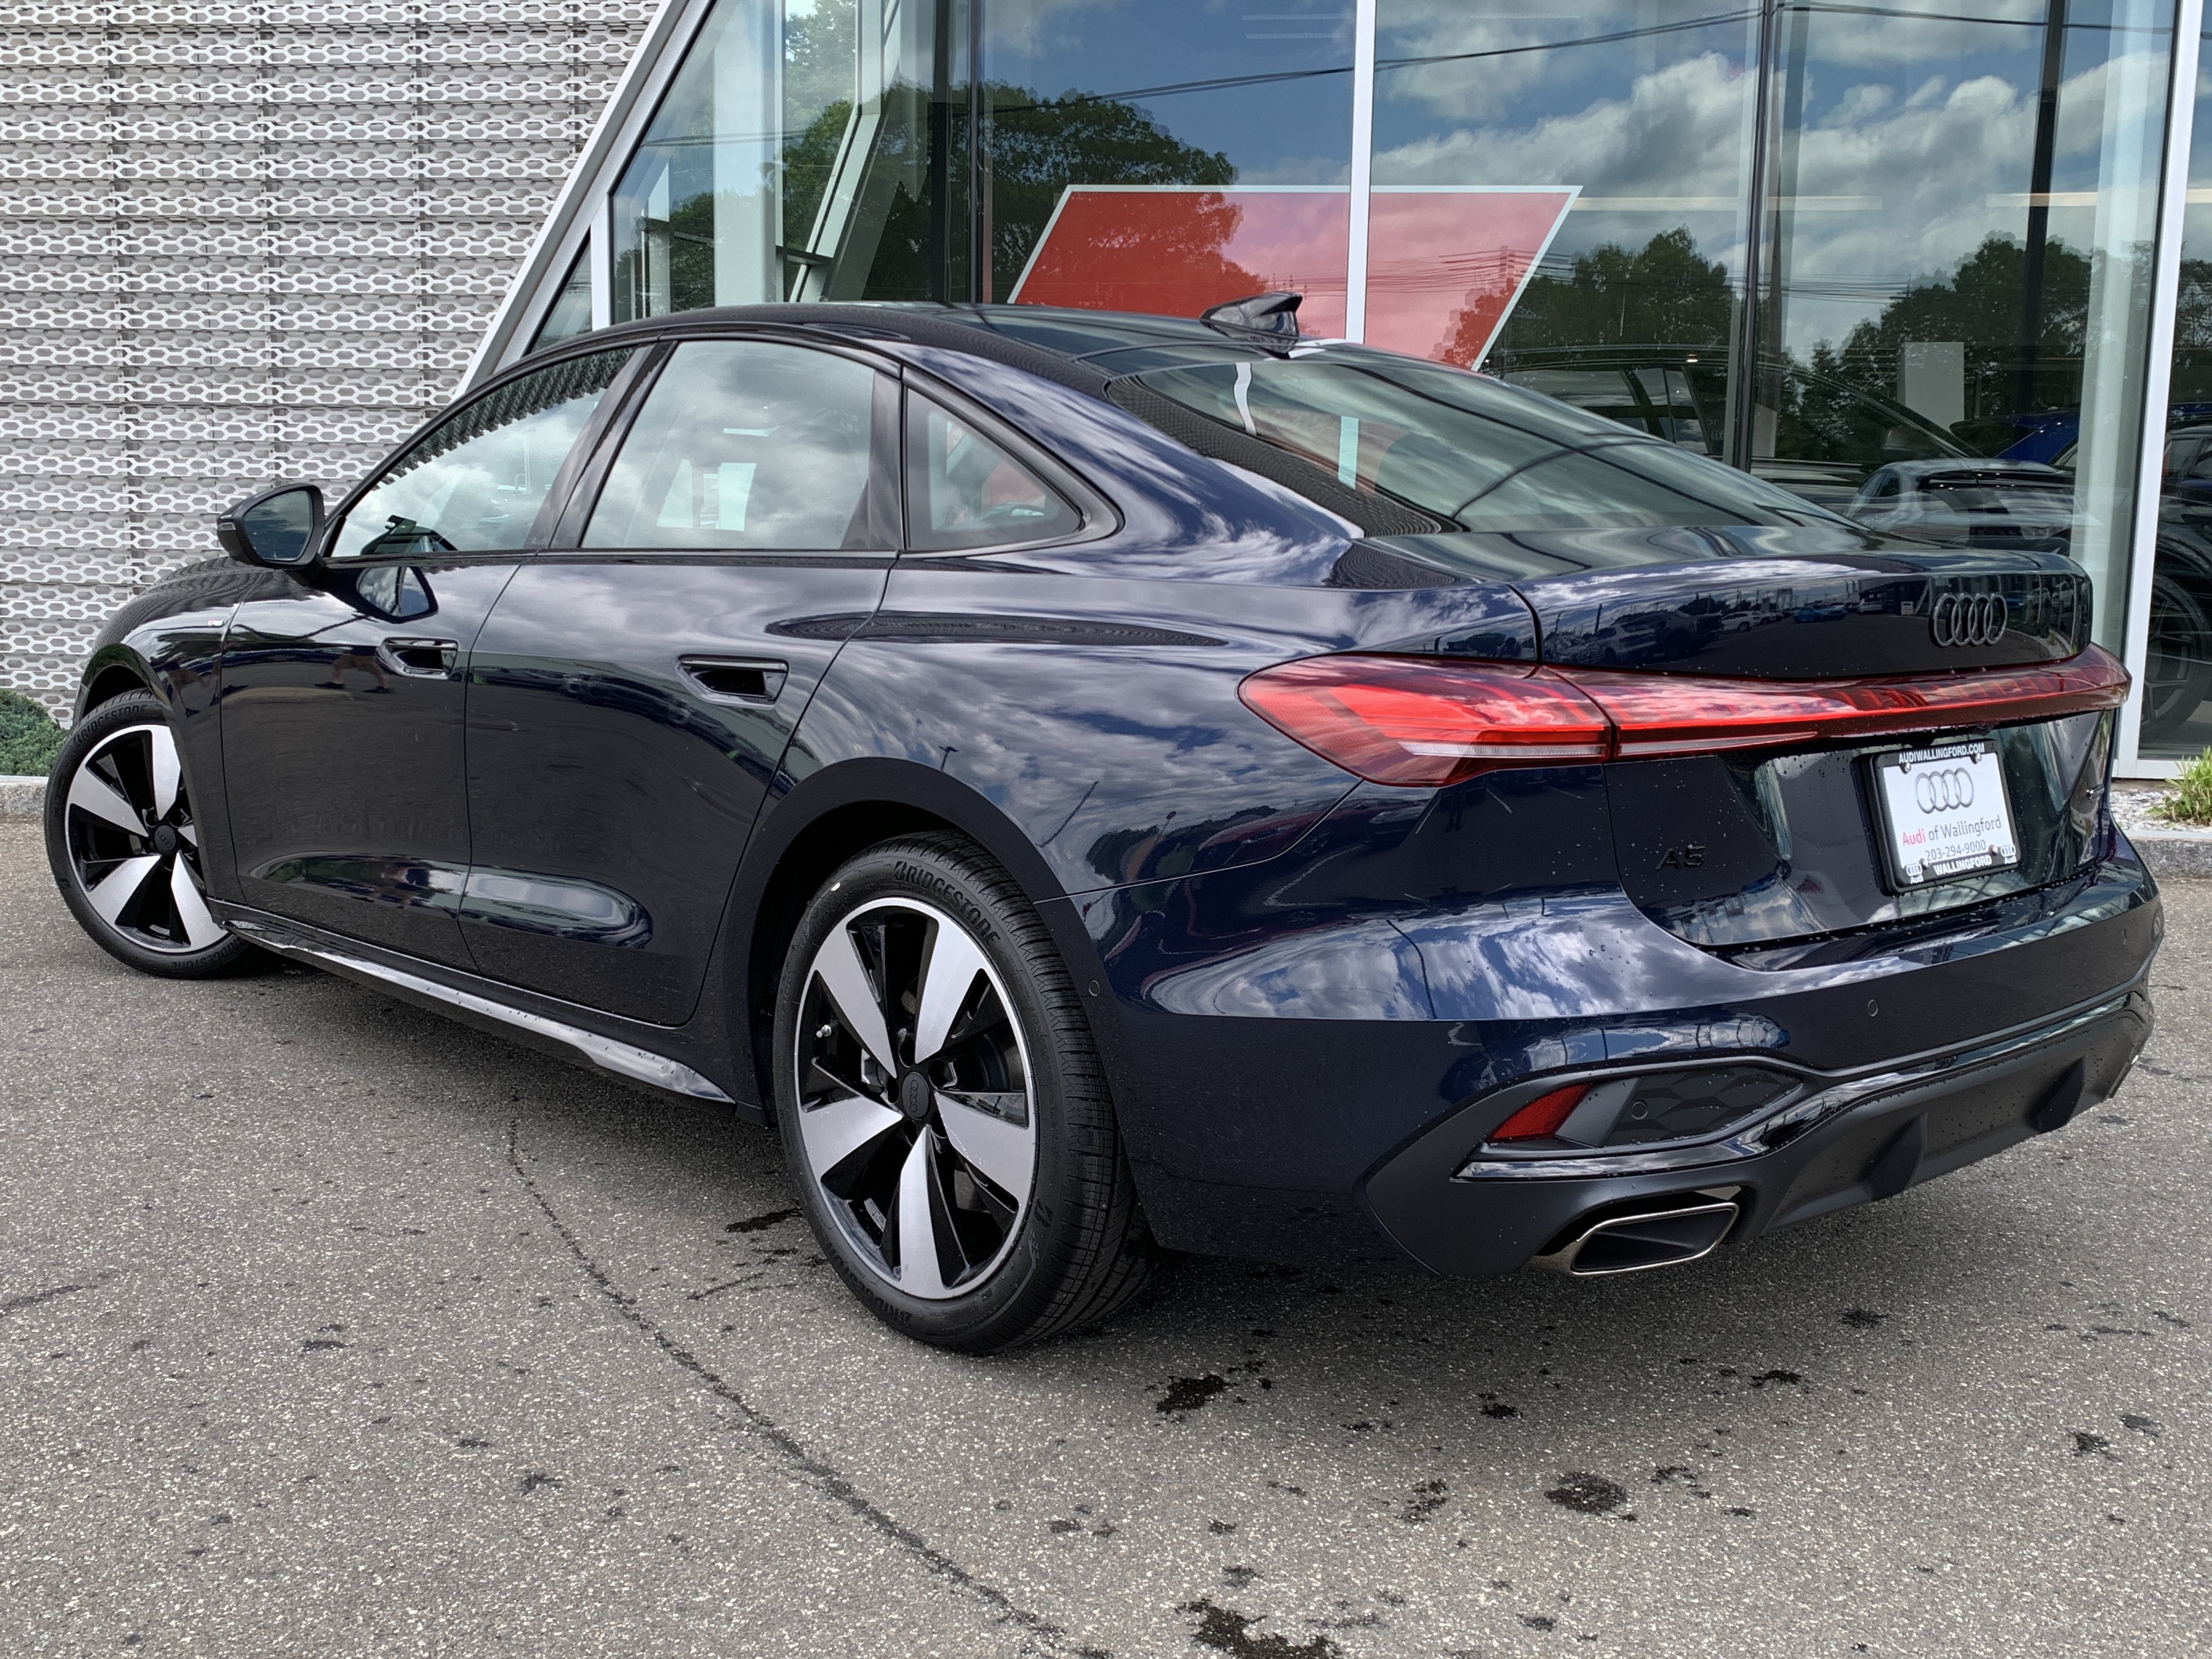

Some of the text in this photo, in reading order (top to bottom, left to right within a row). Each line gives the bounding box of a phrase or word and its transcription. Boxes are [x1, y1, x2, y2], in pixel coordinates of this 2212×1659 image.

[1899, 743, 1984, 764] AUDIWALLINGFORD.COM
[1903, 815, 2001, 846] Audi of Wallingford
[1655, 845, 1705, 870] A5
[1925, 839, 1986, 861] 203-294-9000
[1934, 855, 1992, 876] WALLINGFORD
[894, 861, 1001, 945] BRIDGESTONE
